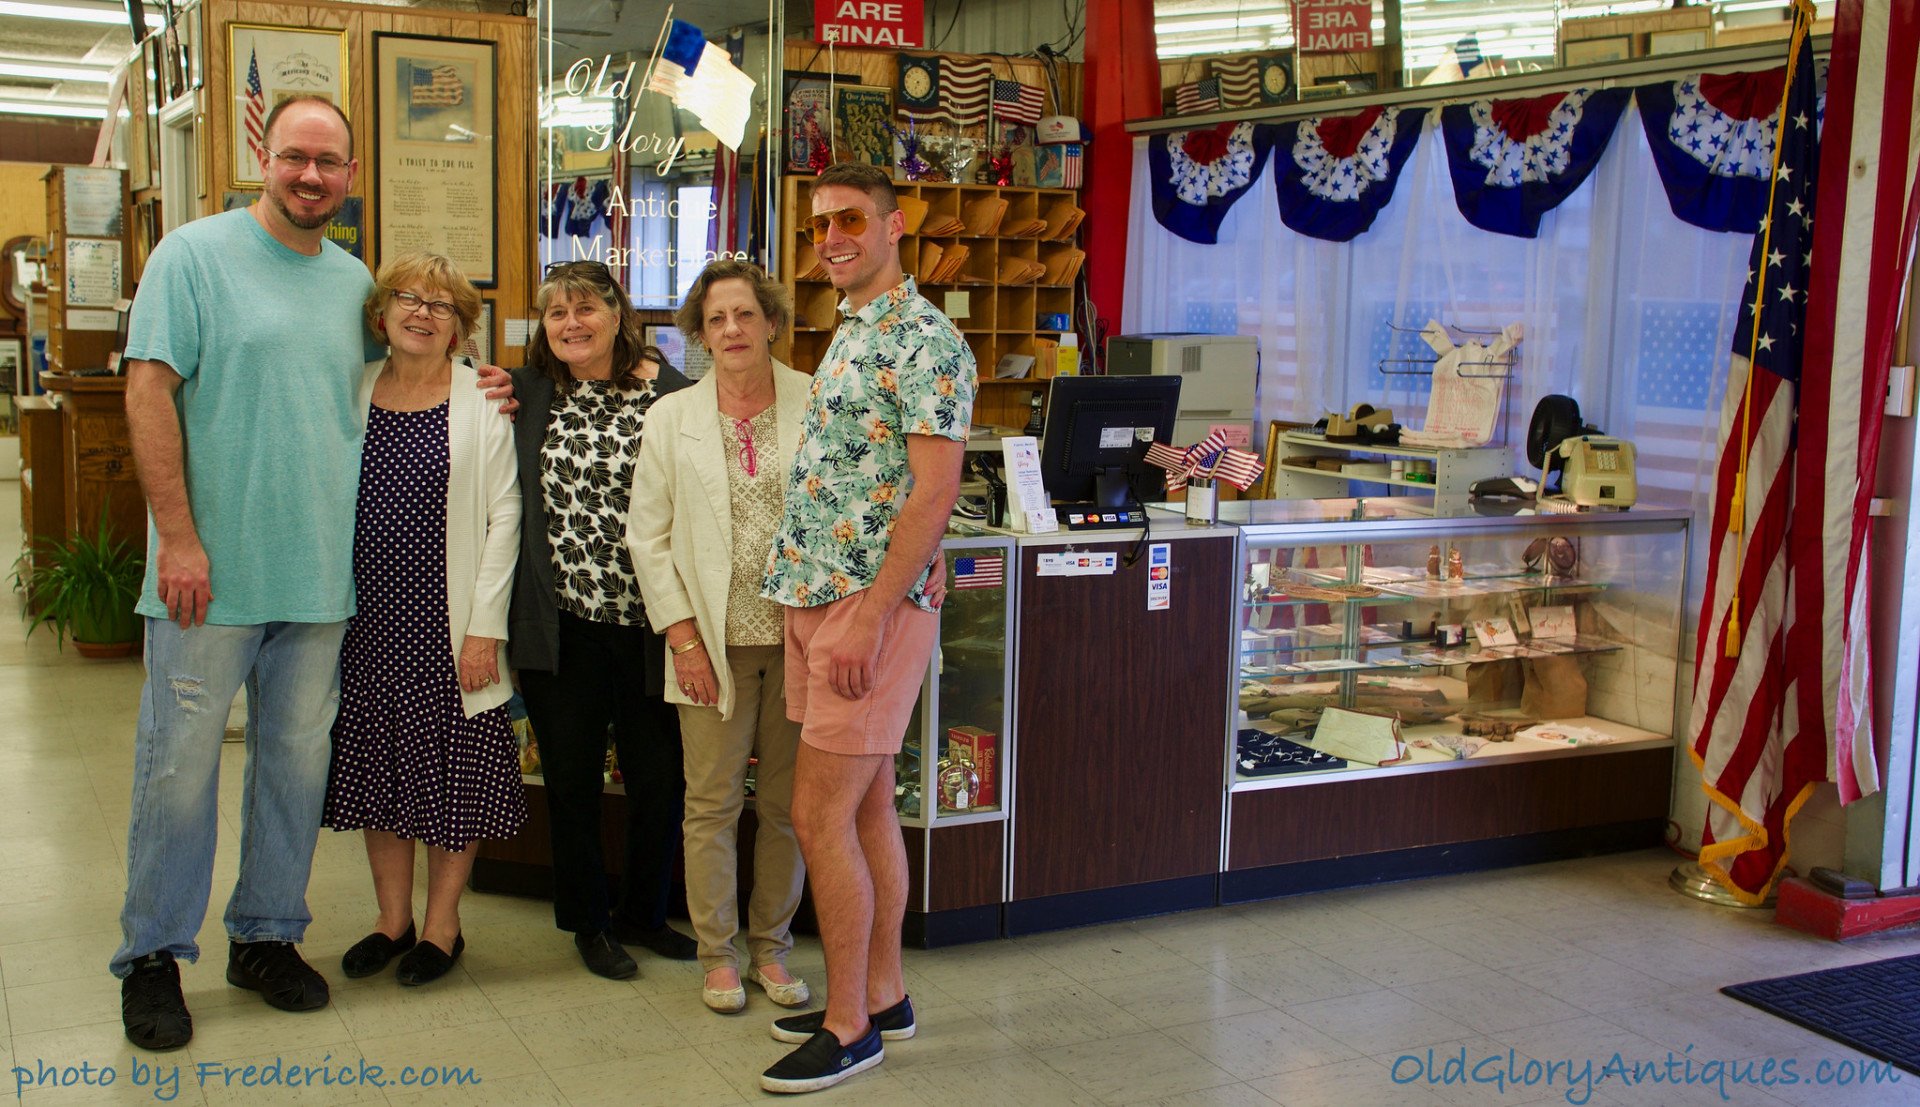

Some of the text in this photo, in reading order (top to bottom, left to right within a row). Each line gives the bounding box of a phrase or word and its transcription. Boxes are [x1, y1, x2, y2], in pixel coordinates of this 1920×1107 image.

[836, 1, 903, 22] ARE
[822, 23, 916, 47] FINAL
[564, 54, 636, 100] Old
[585, 111, 686, 177] Glory
[606, 185, 717, 222] Antiqe
[571, 234, 748, 268] Marketace
[1152, 583, 1168, 591] VISA
